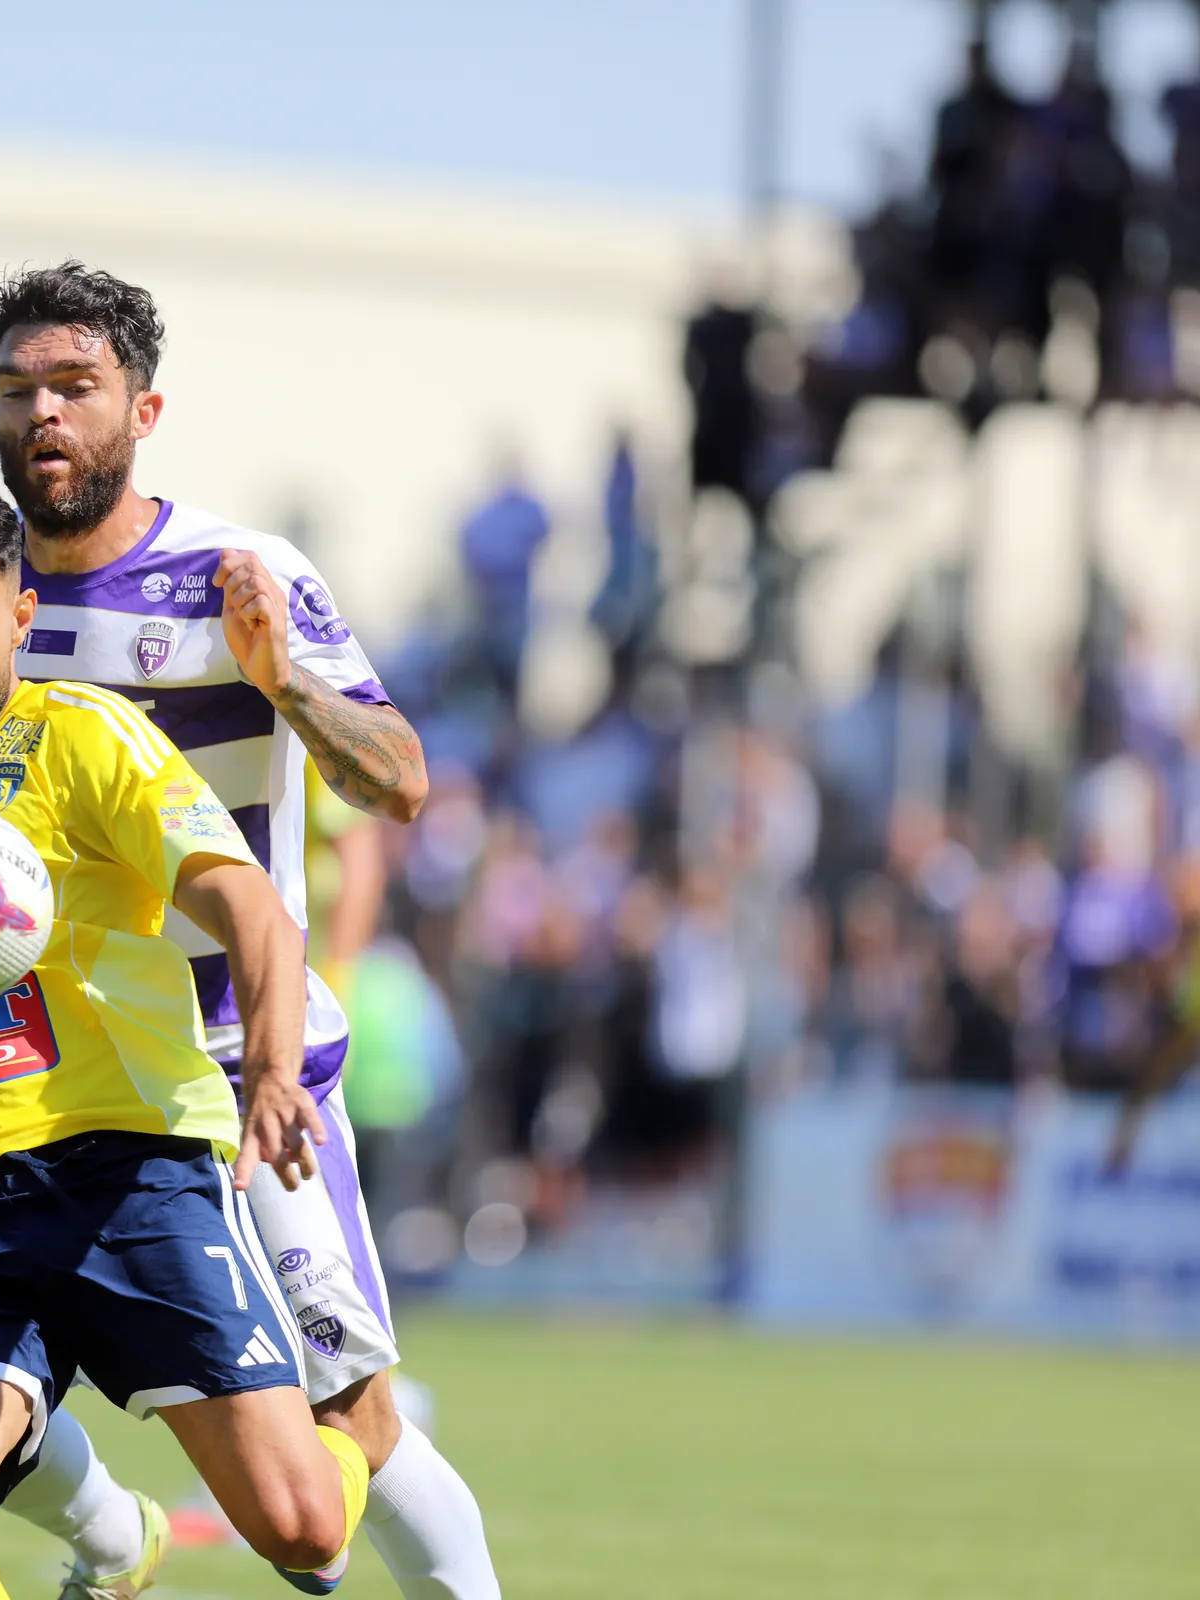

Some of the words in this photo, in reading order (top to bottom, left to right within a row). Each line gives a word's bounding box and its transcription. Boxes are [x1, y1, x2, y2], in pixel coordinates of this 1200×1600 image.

[180, 574, 206, 589] AQUA
[174, 589, 207, 603] BRAVA
[140, 640, 166, 657] POLI
[143, 656, 159, 671] T
[203, 1245, 248, 1311] 7
[308, 1318, 339, 1340] POLI
[319, 1335, 336, 1353] T
